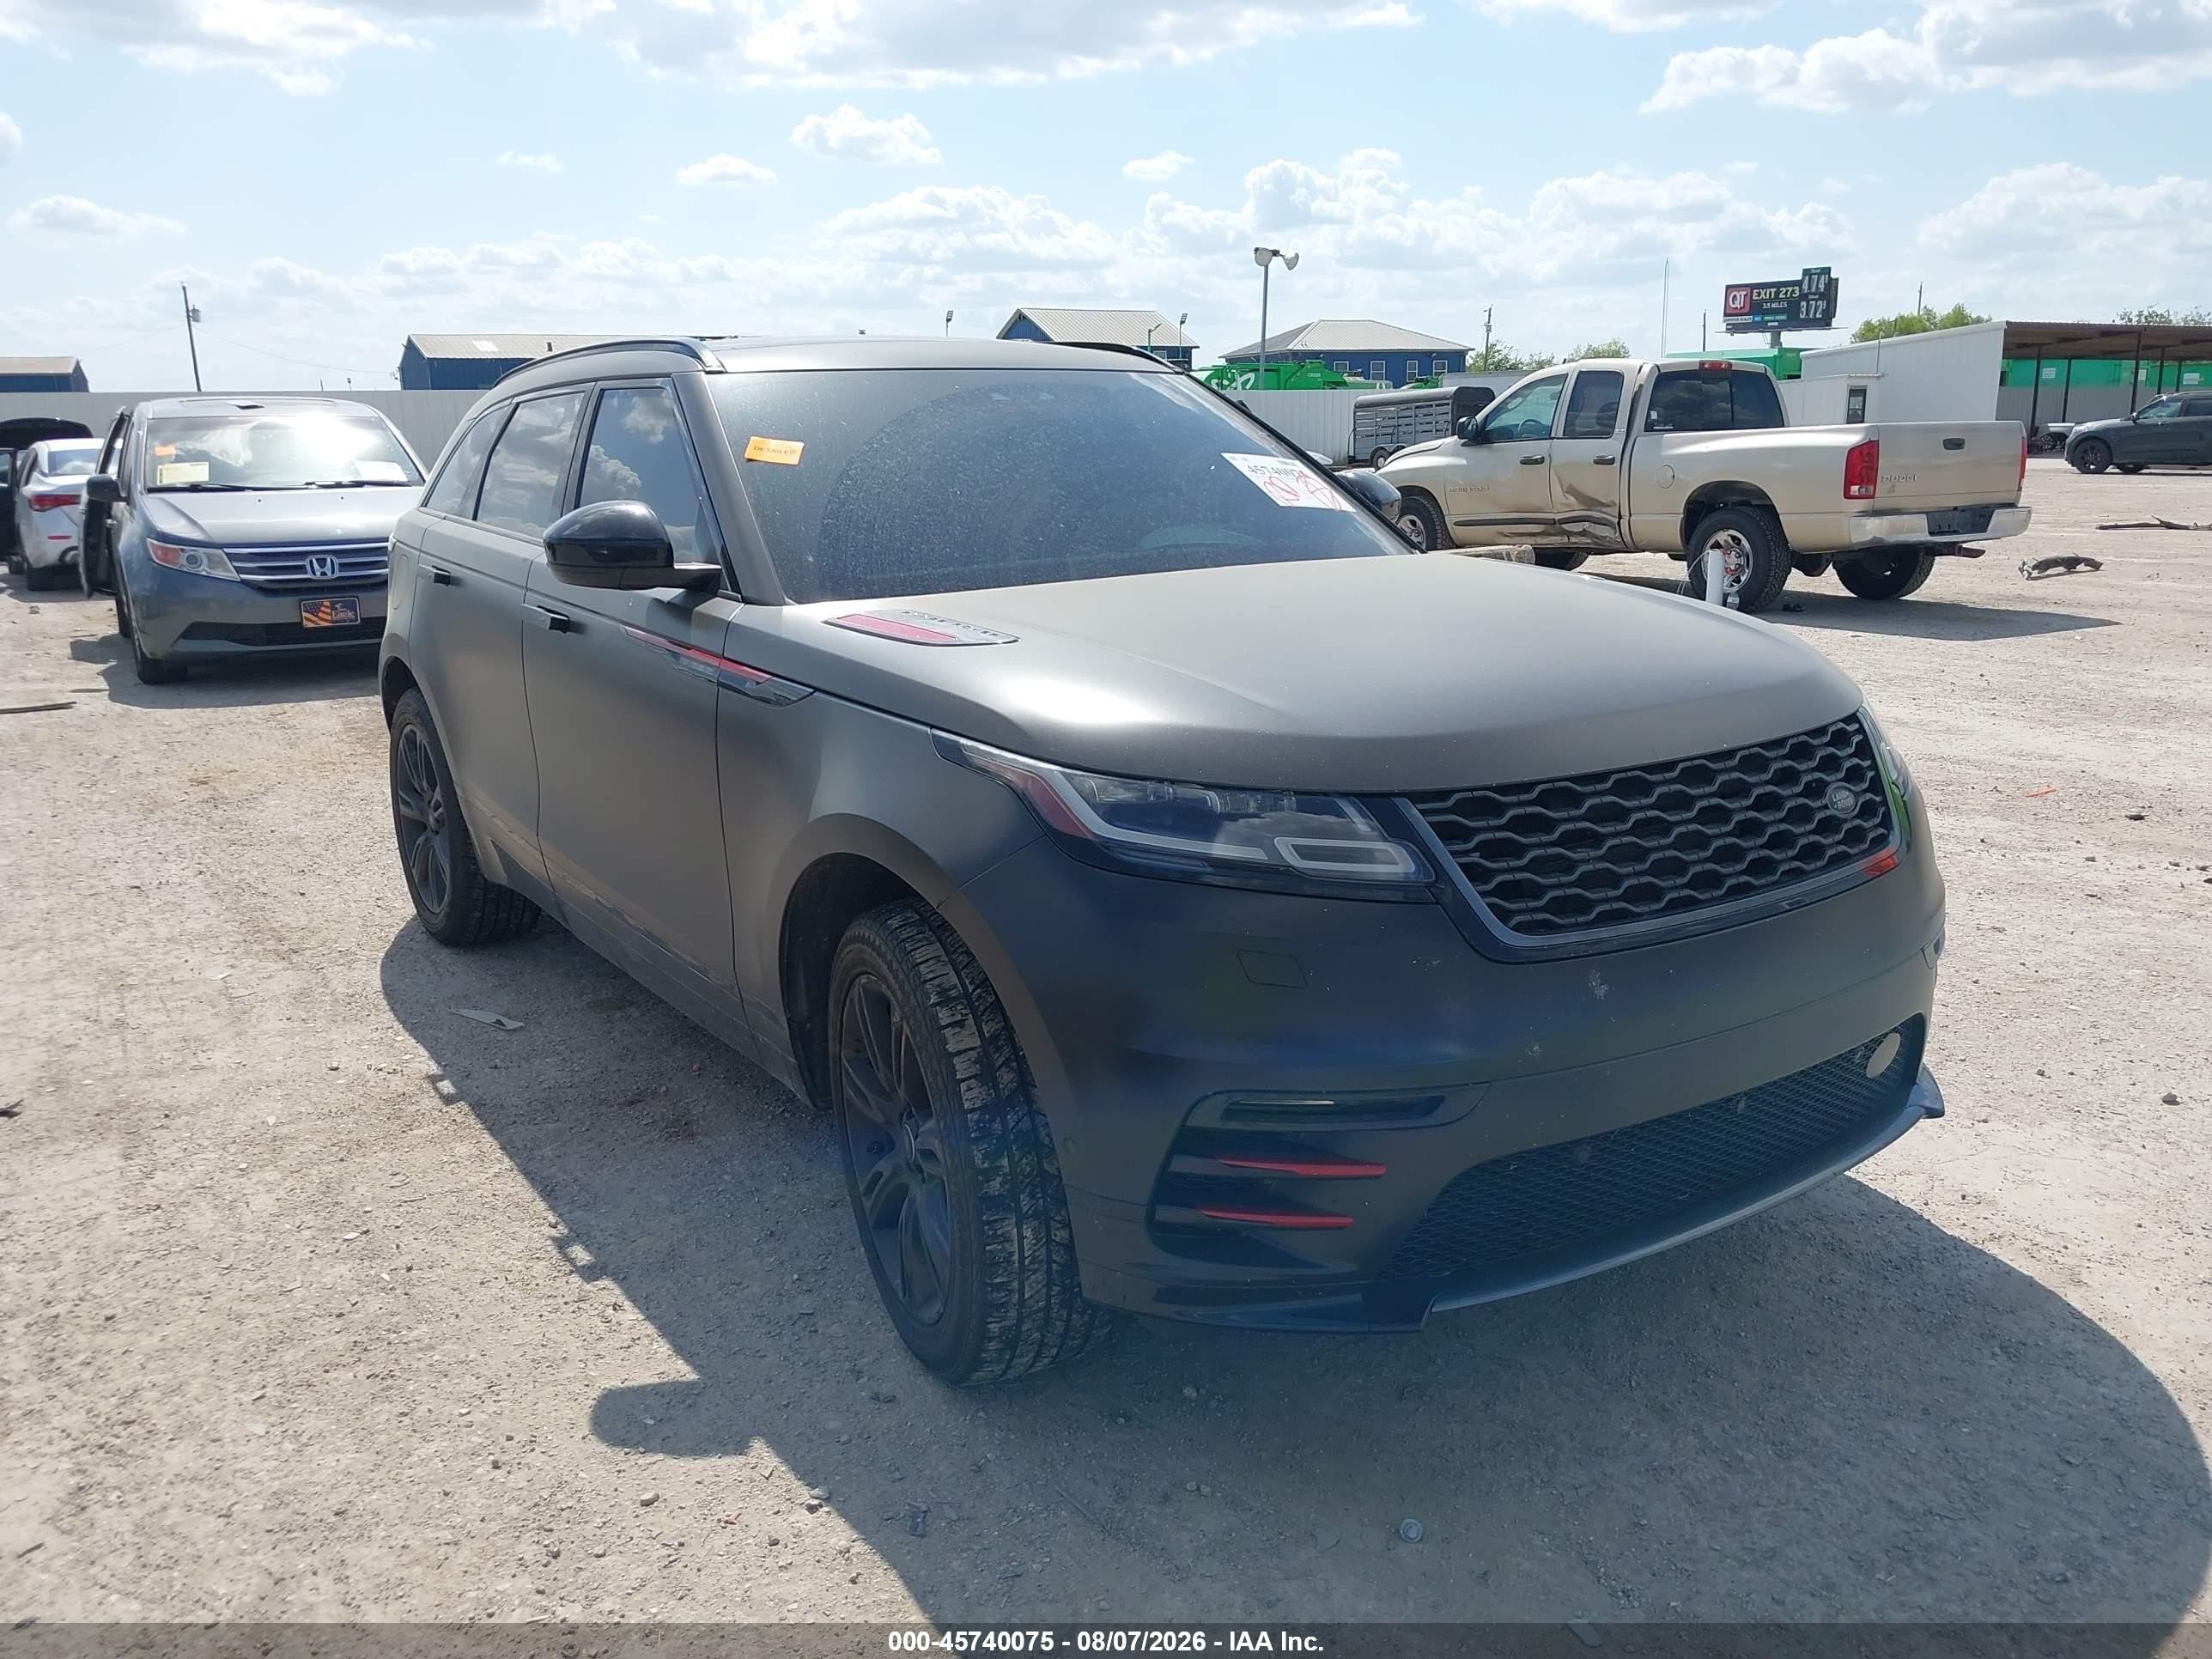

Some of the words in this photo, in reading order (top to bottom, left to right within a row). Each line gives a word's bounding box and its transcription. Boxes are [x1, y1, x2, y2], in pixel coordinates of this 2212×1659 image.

[1729, 291, 1747, 309] QT
[1753, 289, 1777, 300] EXIT
[1778, 286, 1800, 299] 273
